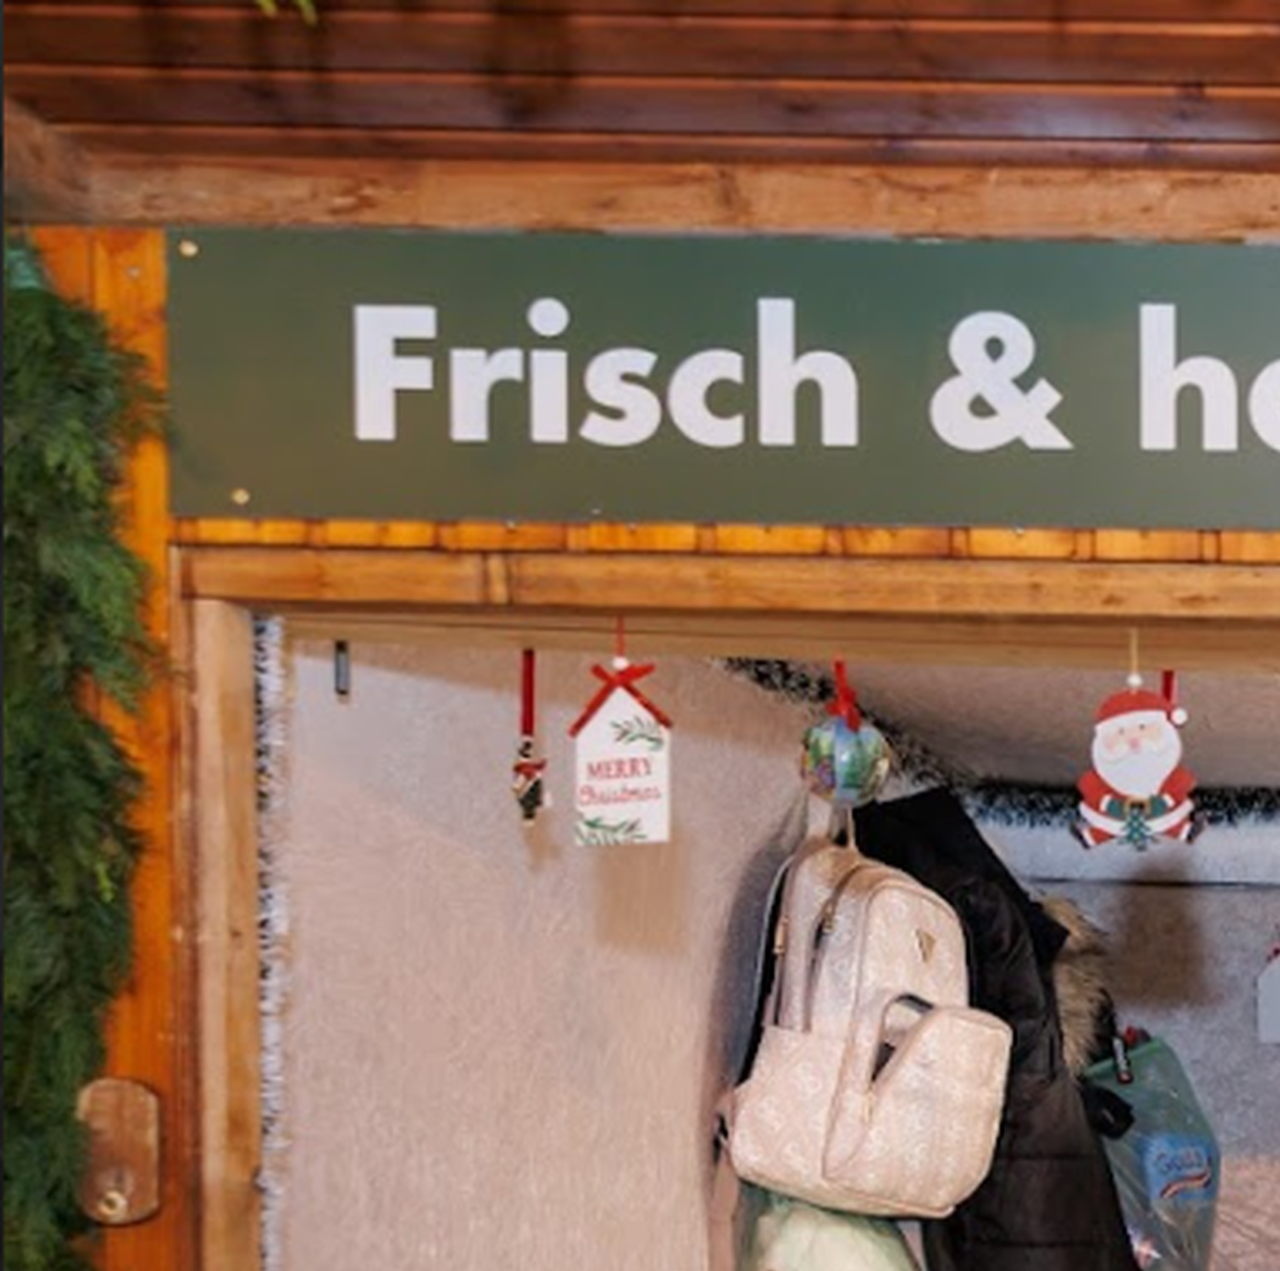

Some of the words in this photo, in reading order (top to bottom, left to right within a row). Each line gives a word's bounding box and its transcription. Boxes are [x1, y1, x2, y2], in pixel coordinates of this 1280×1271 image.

[354, 297, 859, 447] Frisch
[929, 310, 1075, 452] &
[586, 757, 653, 781] MERRY
